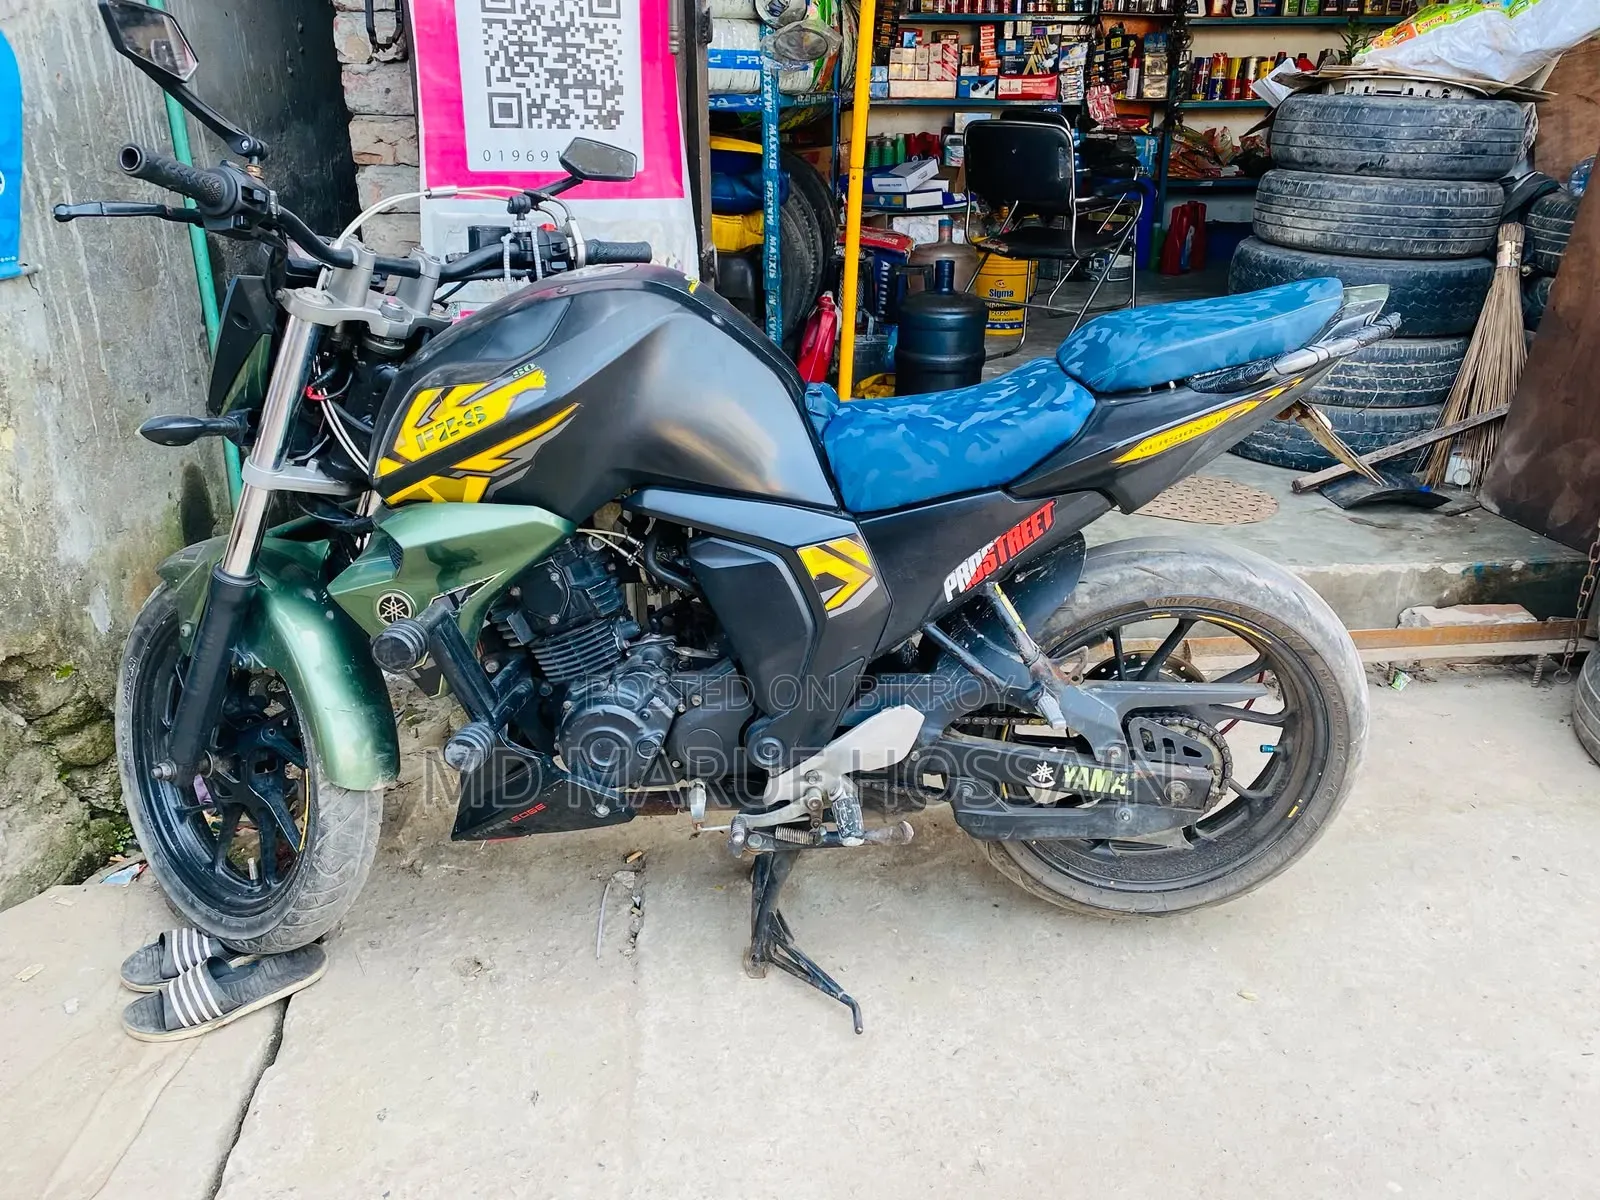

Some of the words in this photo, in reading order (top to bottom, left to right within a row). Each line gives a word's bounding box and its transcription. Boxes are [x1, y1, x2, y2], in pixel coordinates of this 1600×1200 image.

[768, 123, 778, 169] MAXXIS
[766, 180, 774, 225] MAXXIS
[989, 288, 1014, 298] Sigma
[415, 405, 488, 453] FZ-S
[943, 498, 1056, 603] PROSTREET
[1063, 764, 1133, 796] YAMA
